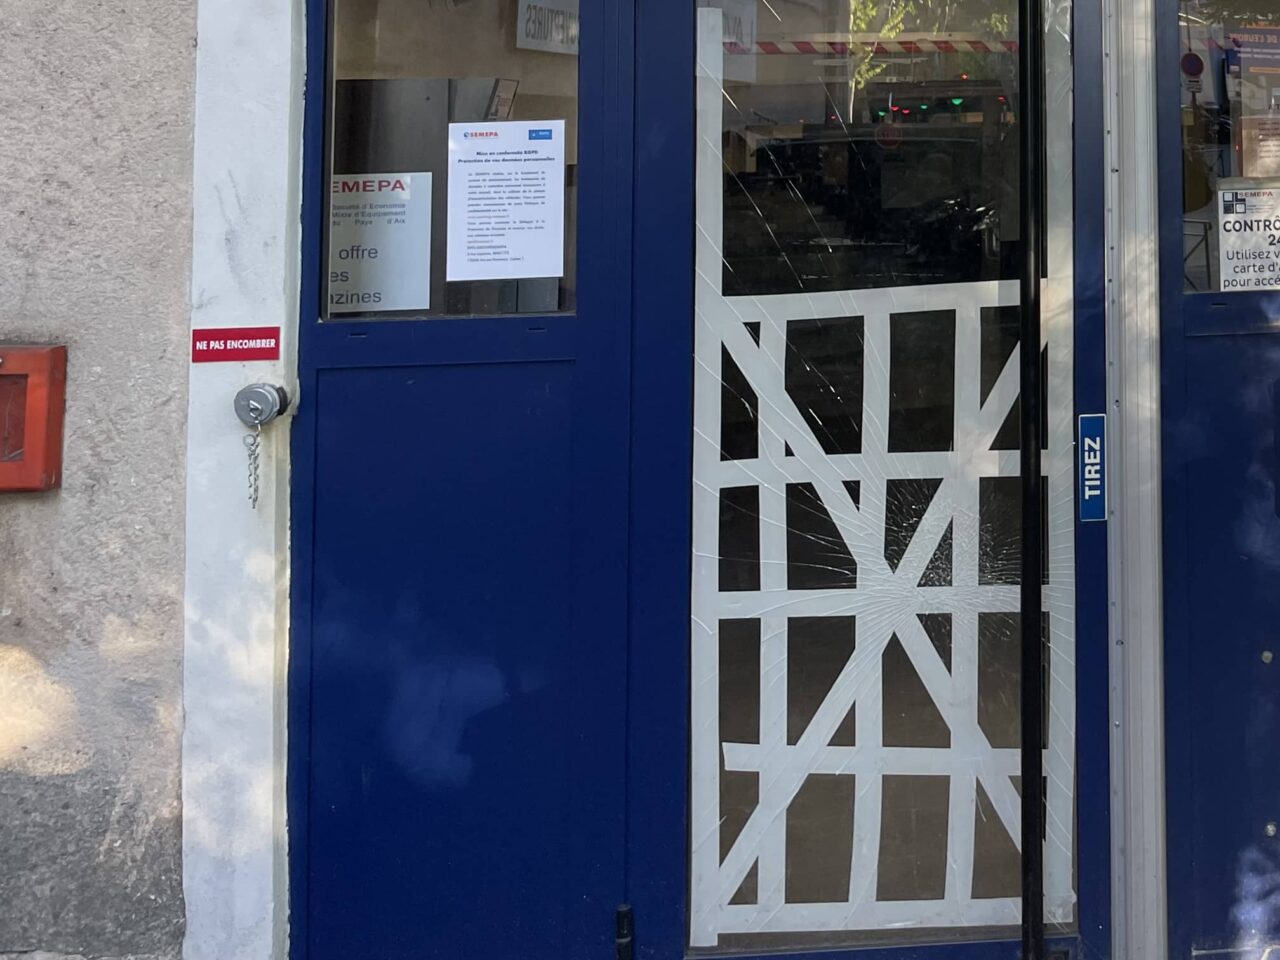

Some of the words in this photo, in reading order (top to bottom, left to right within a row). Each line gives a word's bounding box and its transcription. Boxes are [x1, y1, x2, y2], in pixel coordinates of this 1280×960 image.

[338, 244, 378, 260] offre
[1226, 249, 1271, 261] Utilisez
[1233, 263, 1265, 274] carte
[1223, 278, 1251, 290] pour
[196, 341, 208, 350] NE
[209, 340, 225, 350] PAS
[226, 339, 276, 349] ENCOMBRER
[1084, 437, 1101, 500] TIREZ
